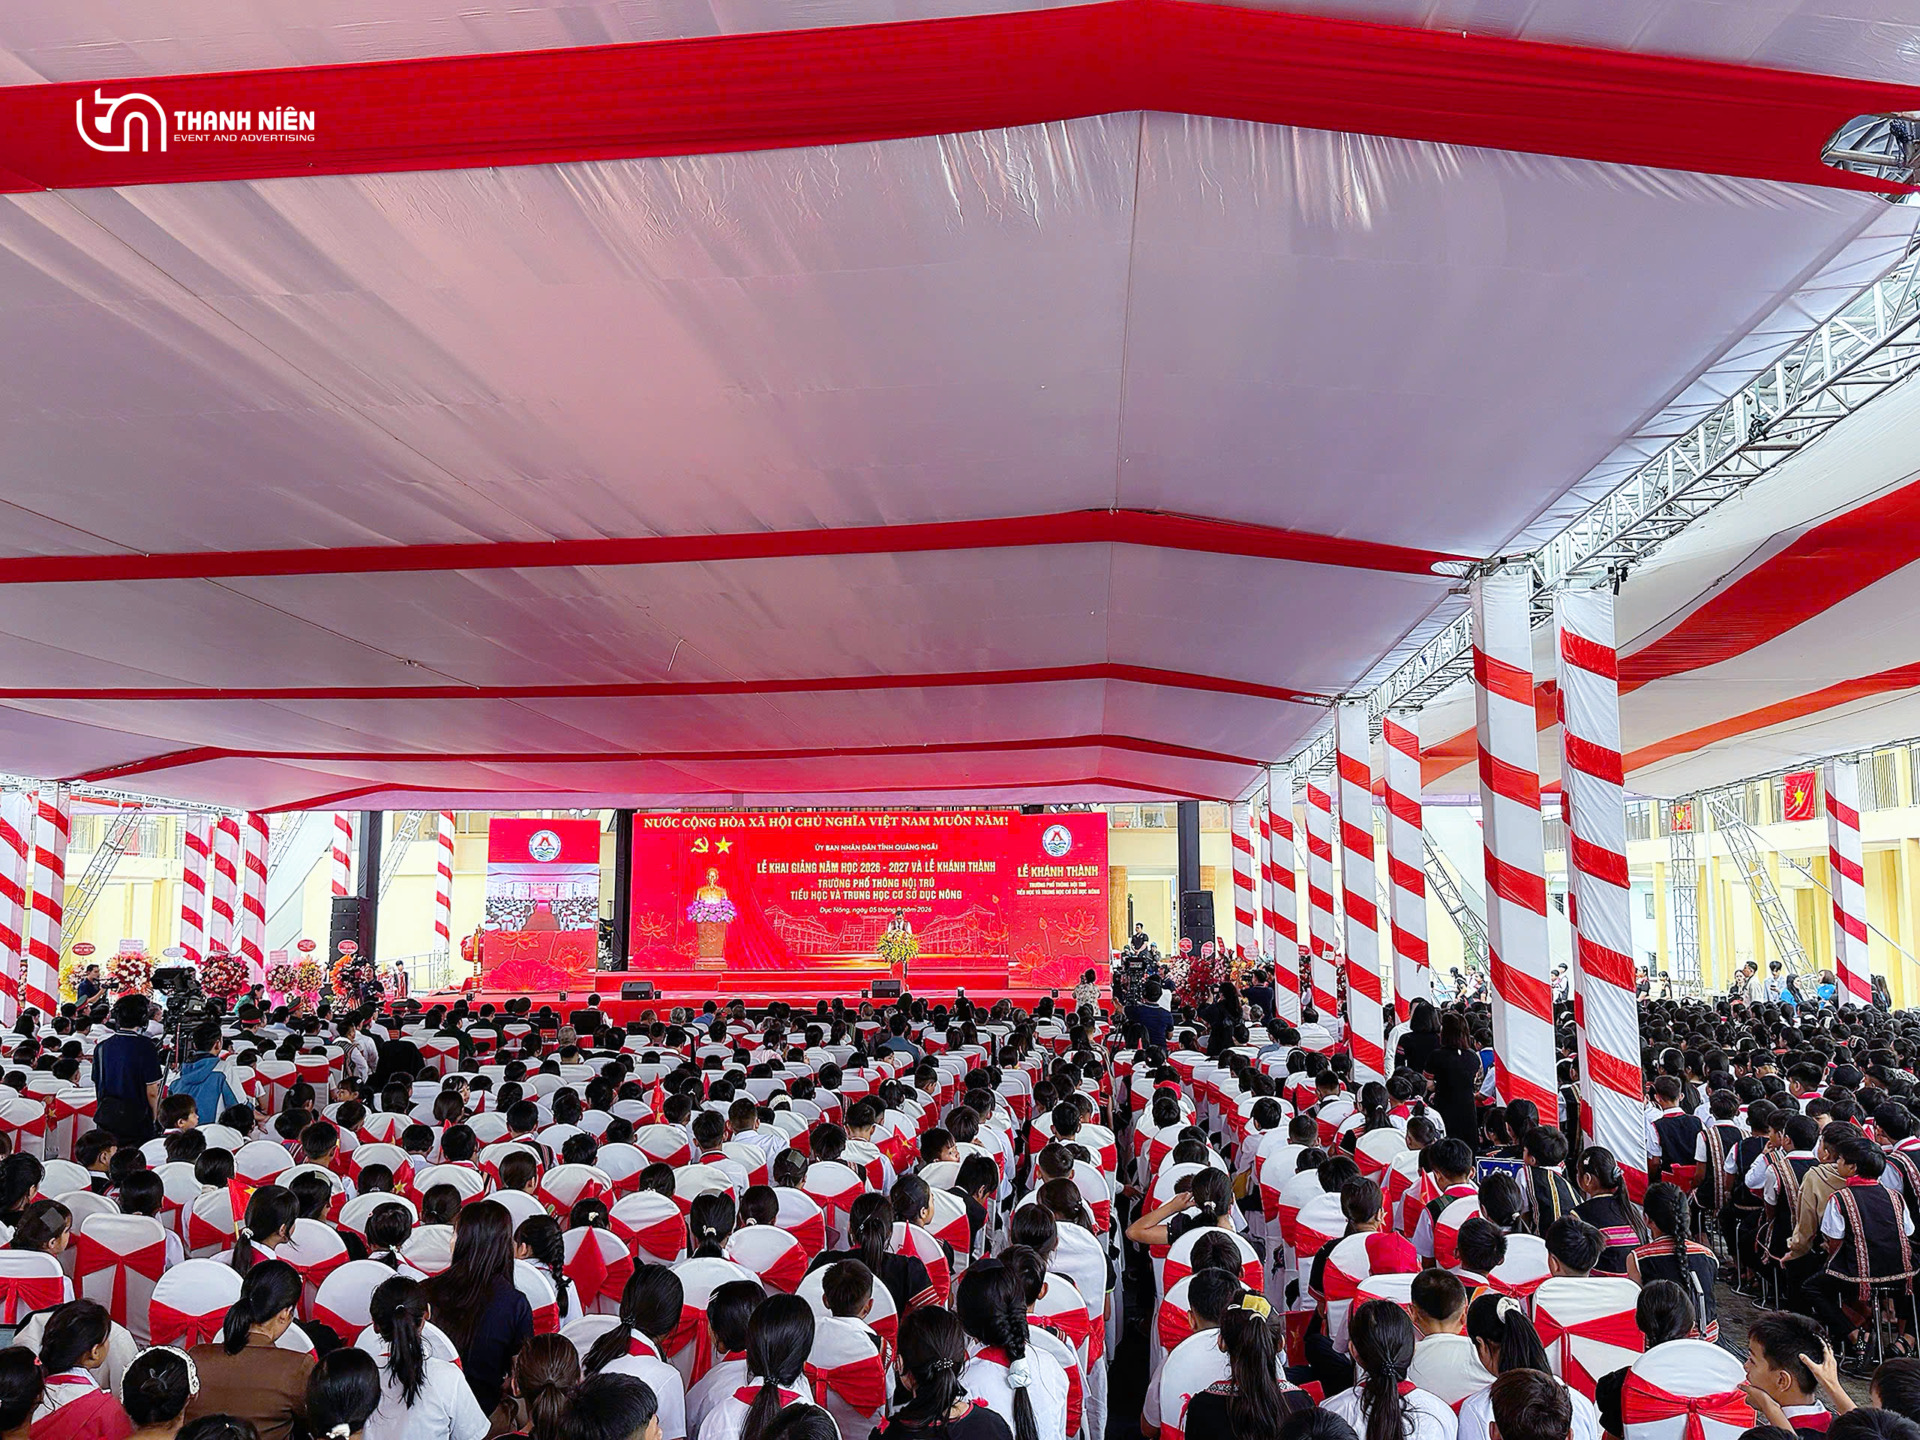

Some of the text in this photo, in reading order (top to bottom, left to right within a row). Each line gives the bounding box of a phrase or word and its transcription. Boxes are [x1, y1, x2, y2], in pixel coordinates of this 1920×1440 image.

[644, 814, 1009, 829] NƯỚC CỘNG HÒA XÃ HỘI CHỦ NGHĨA VIỆT NAM MUÔN NĂM!
[841, 843, 860, 851] NHÂN
[861, 843, 876, 851] DÂN
[757, 859, 767, 874] LỄ
[769, 862, 789, 874] KHAI
[791, 859, 817, 874] GIẢNG
[819, 860, 839, 873] NĂM
[841, 862, 858, 875] HỌC
[860, 862, 881, 873] 2026
[889, 862, 909, 873] 2027
[911, 859, 922, 873] VÀ
[925, 858, 935, 872] LỄ
[937, 860, 966, 872] KHÁNH
[967, 859, 996, 872] THÀNH
[1017, 863, 1098, 877] LỄ KHÁNH THÀNH
[818, 876, 935, 889] TRƯỜNG PHỔ THÔNG NỘI TRÚ
[790, 888, 962, 901] TIỂU HỌC VÀ TRUNG HỌC CƠ SỞ DỤC NÔNG
